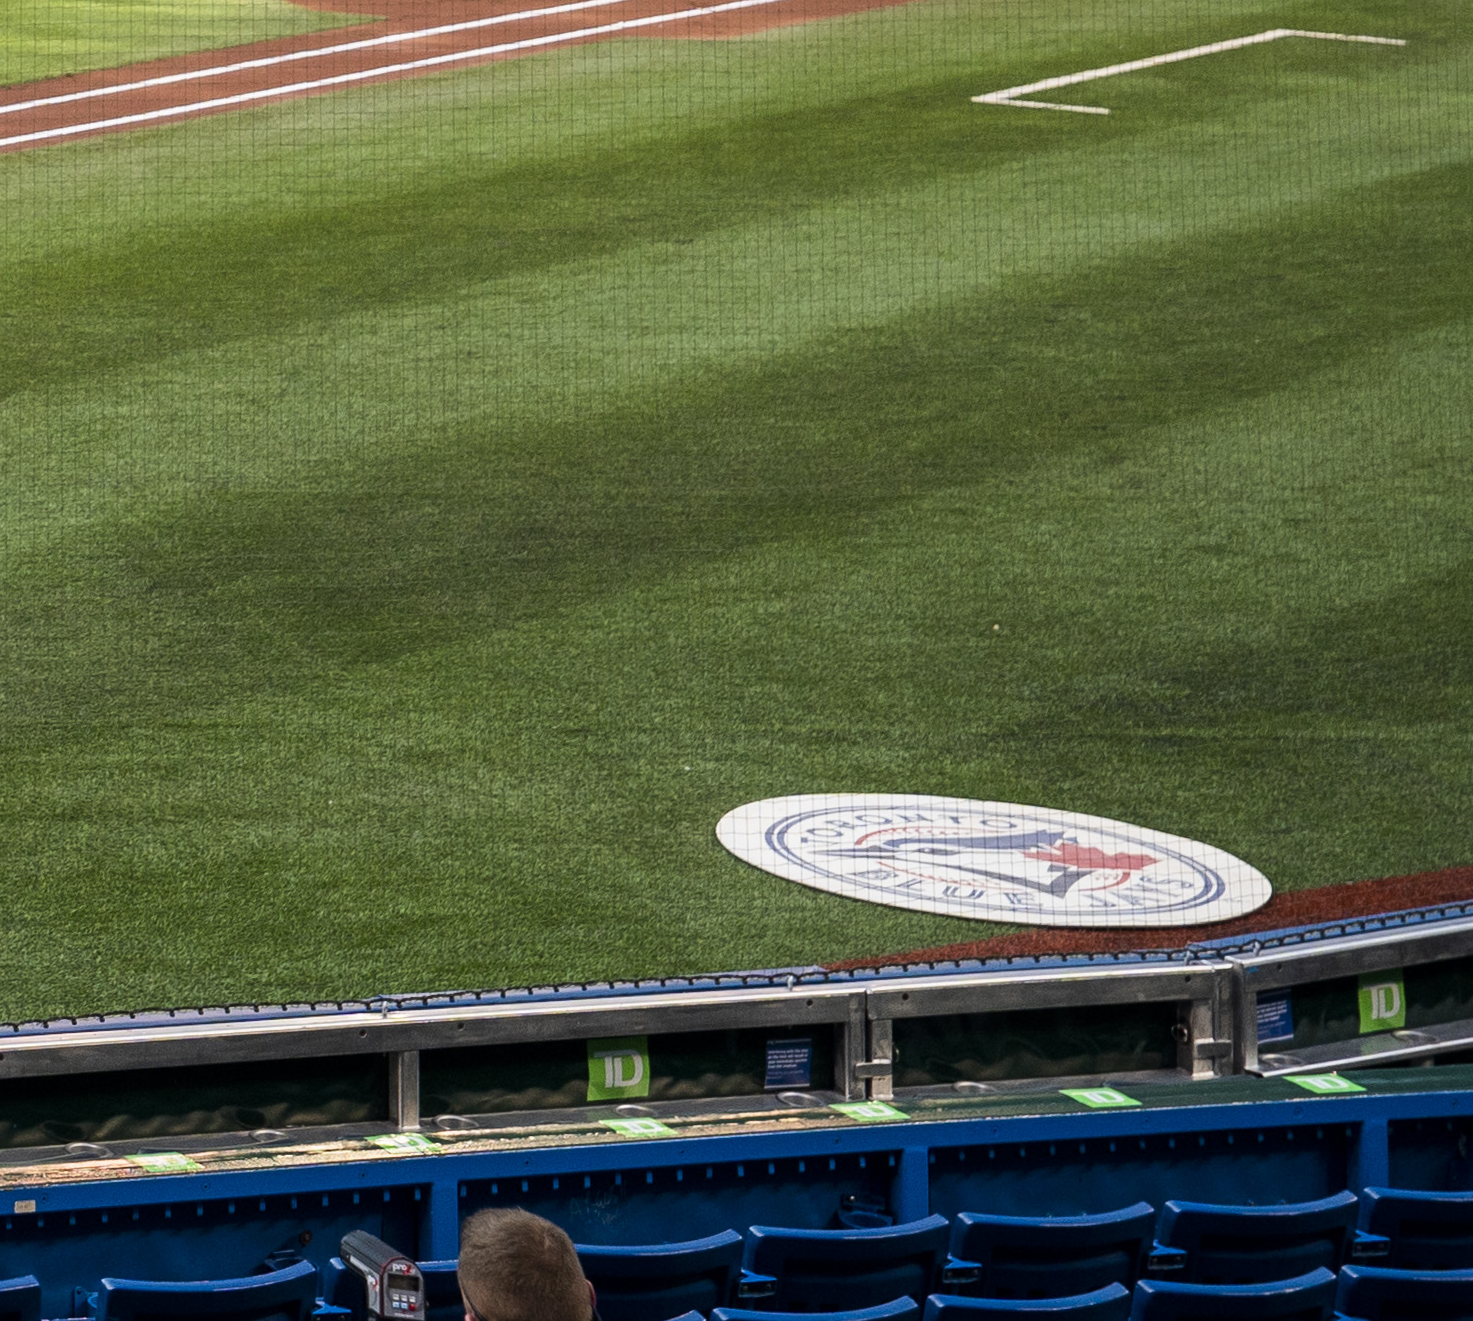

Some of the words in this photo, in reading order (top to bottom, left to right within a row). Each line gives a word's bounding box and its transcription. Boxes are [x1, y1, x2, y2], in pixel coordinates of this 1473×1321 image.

[798, 811, 1017, 849] TORONTO
[851, 869, 1038, 907] BLUE
[1082, 873, 1196, 909] JAYS
[1362, 983, 1400, 1019] TD
[594, 1048, 643, 1089] TD
[1295, 1076, 1350, 1089] TD
[1080, 1089, 1127, 1104] TD
[849, 1102, 897, 1119] TD
[617, 1119, 663, 1135] TD
